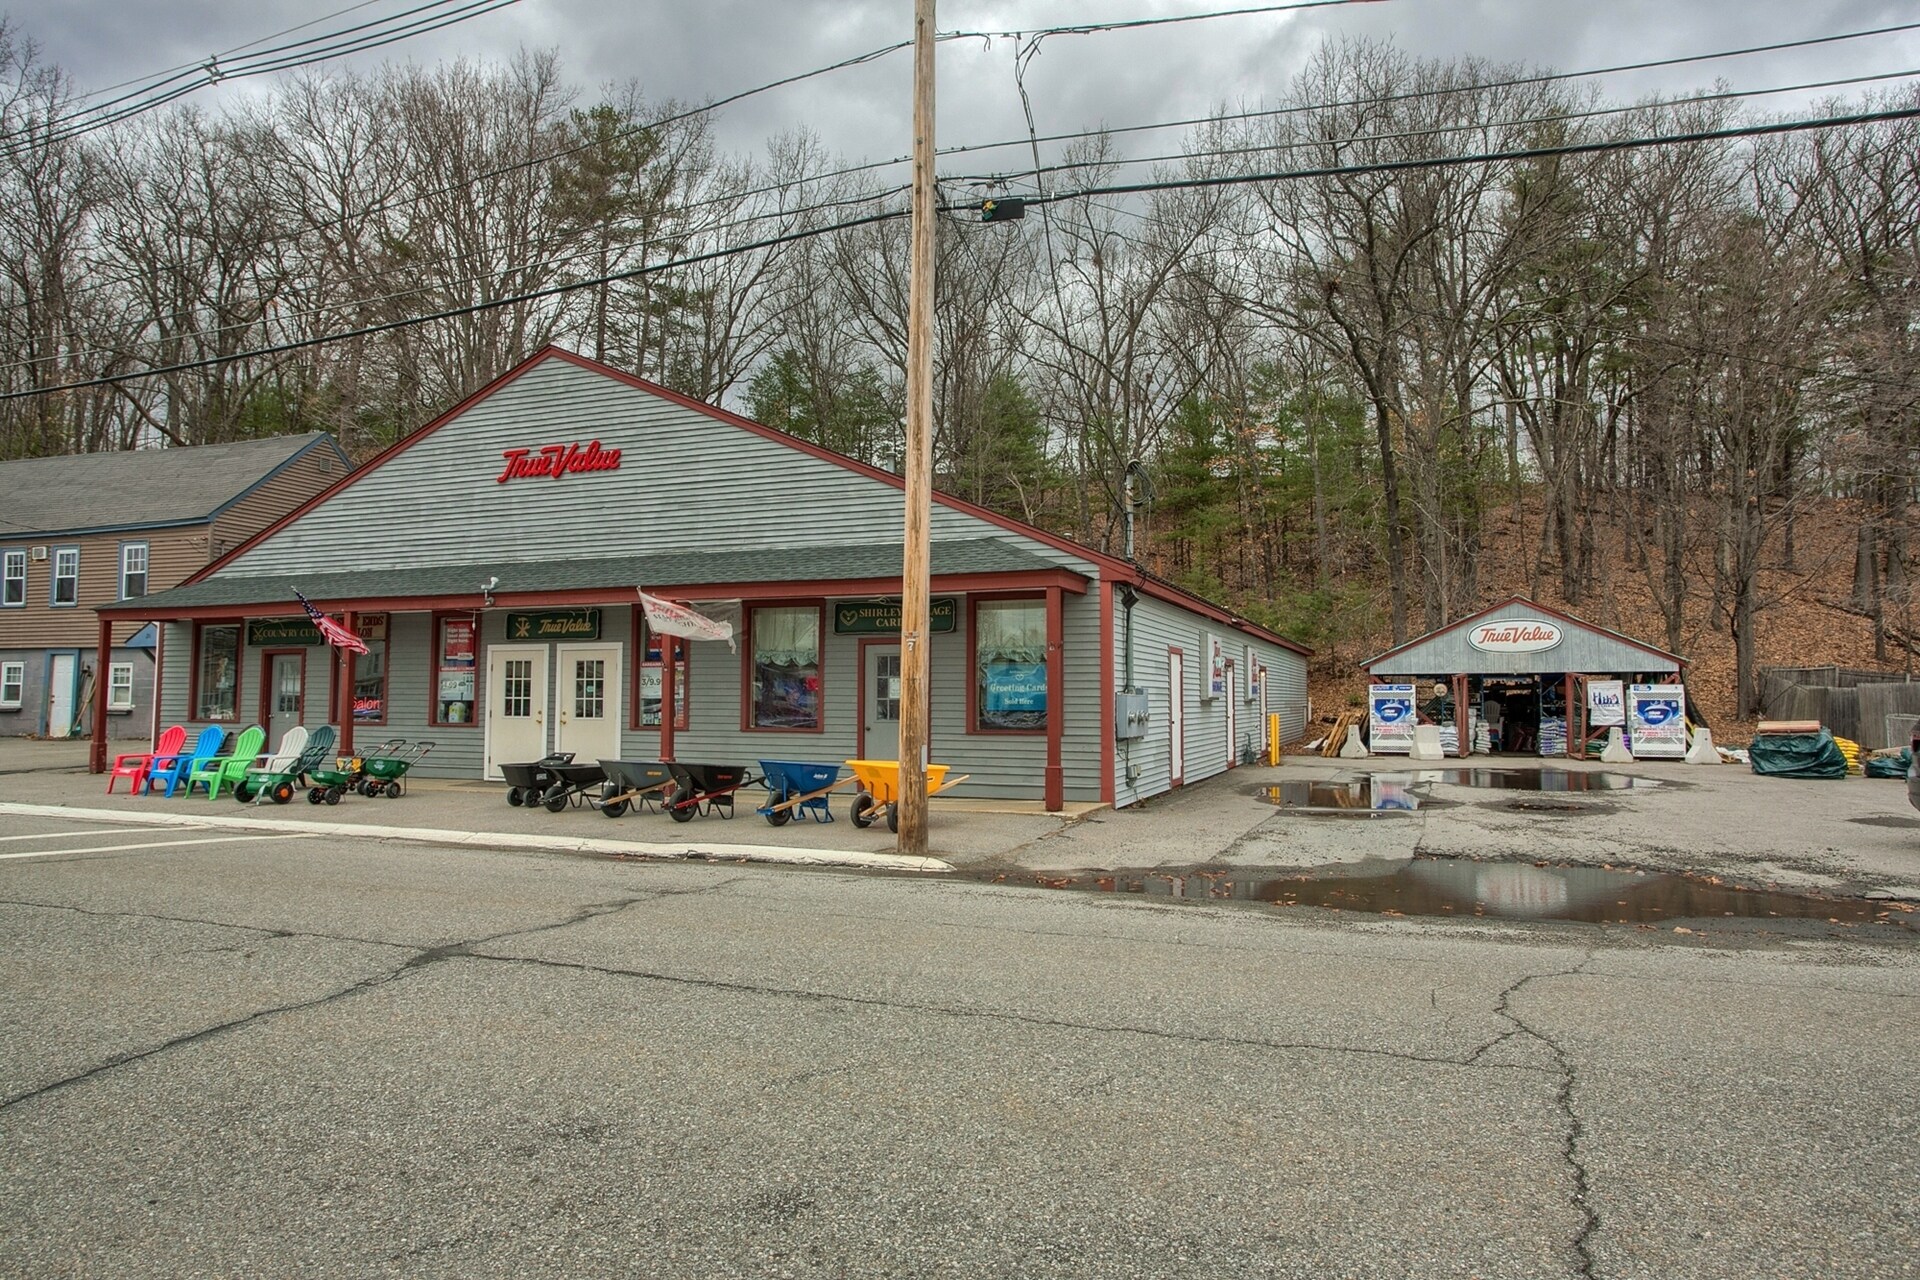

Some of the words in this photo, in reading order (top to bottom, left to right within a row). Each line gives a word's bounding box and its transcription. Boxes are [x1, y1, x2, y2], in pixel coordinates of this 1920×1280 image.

[641, 677, 661, 687] 3/9.9
[990, 683, 1025, 693] Greeting
[1004, 697, 1018, 705] Sold
[1020, 697, 1034, 705] Here
